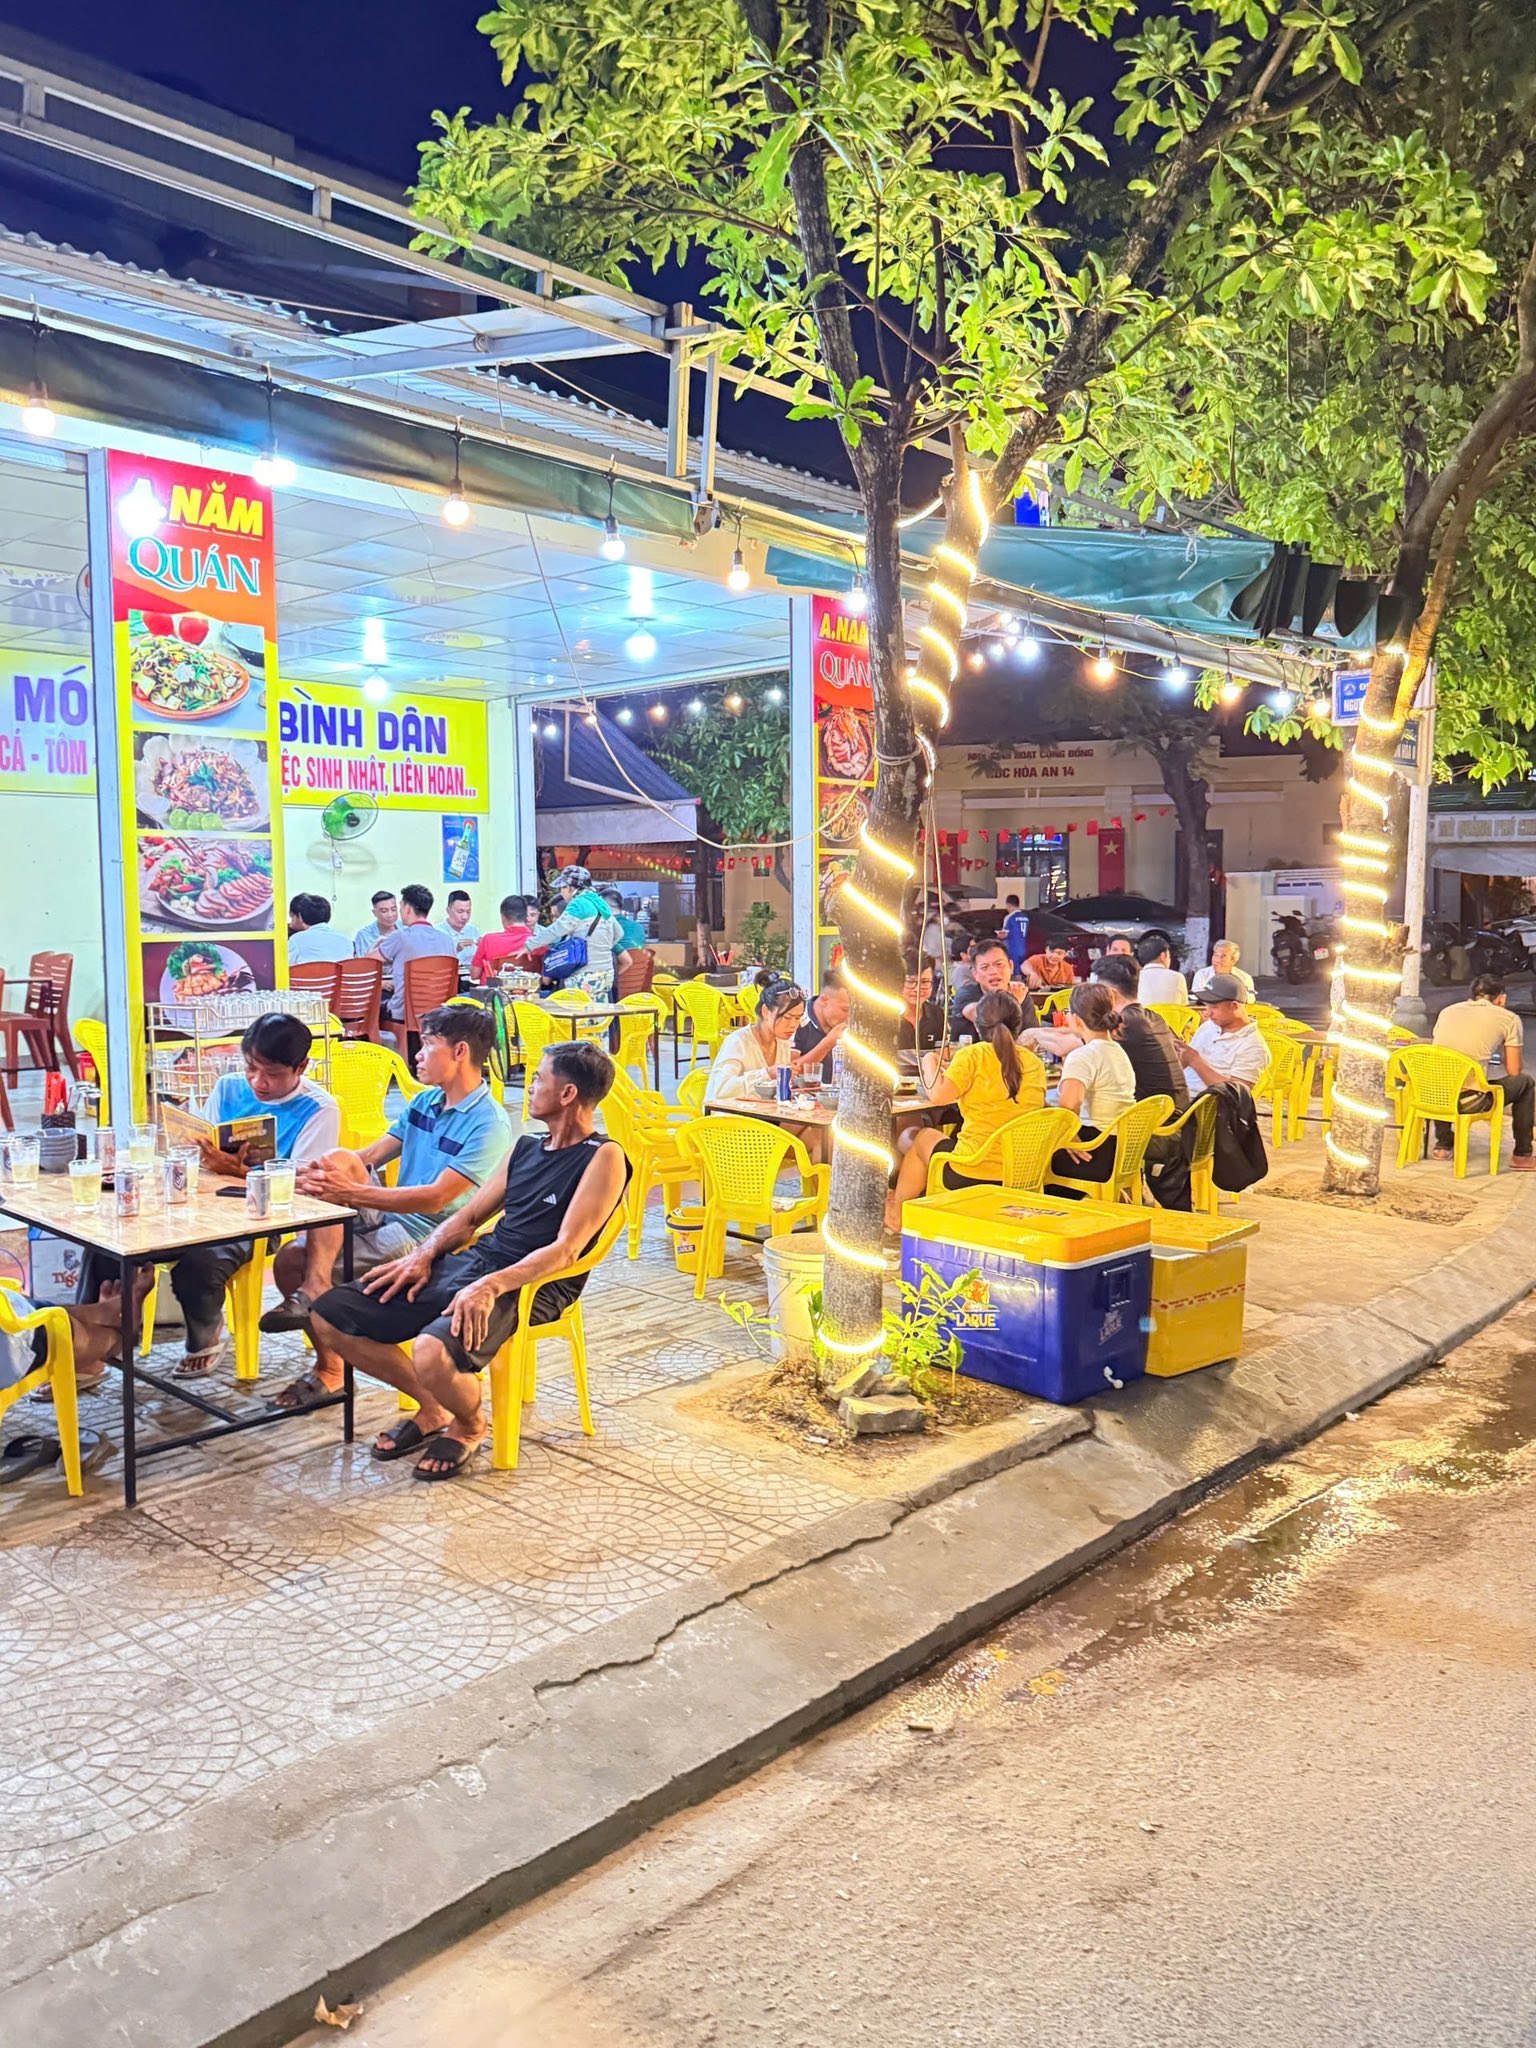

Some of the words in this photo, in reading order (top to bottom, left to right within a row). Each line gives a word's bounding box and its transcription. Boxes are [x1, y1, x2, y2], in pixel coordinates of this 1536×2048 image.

[127, 537, 261, 596] QUÁN
[820, 651, 871, 688] QUÁN
[279, 687, 363, 748] BÌNH
[378, 706, 446, 754] DÂN
[45, 732, 88, 775] TÔM
[1041, 766, 1058, 777] AN
[1062, 765, 1075, 777] 14
[306, 756, 343, 790] SINH
[348, 754, 389, 799] NHẬT,
[393, 757, 423, 794] LIÊN
[428, 765, 476, 797] HOAN...
